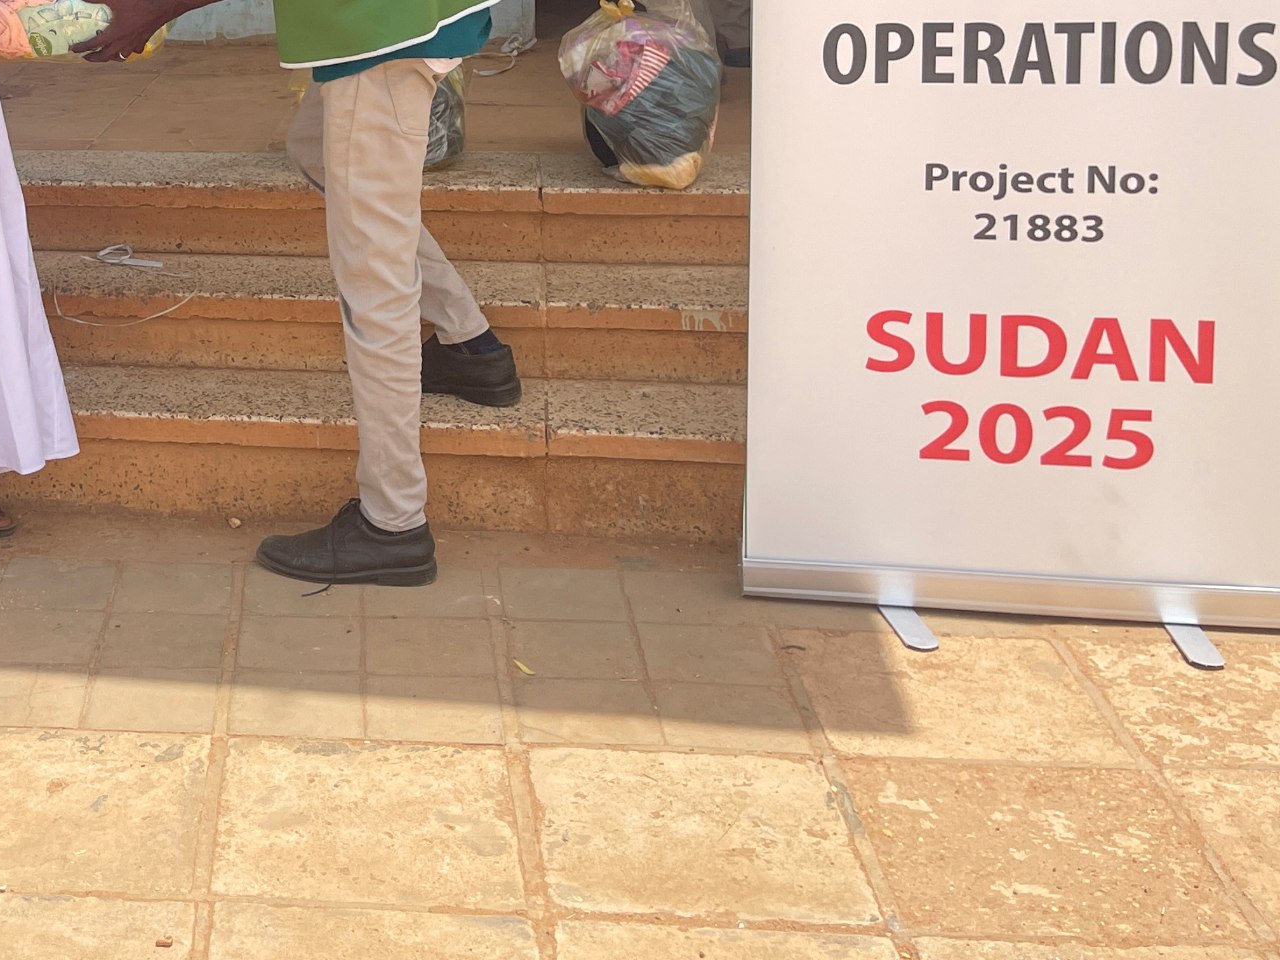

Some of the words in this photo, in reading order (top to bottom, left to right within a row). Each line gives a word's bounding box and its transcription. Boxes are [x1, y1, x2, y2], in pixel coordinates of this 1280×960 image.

[822, 20, 1278, 87] OPERATIONS
[924, 162, 1075, 201] Project
[1087, 165, 1159, 195] No:
[973, 212, 1105, 243] 21883
[865, 309, 1216, 385] SUDAN
[918, 399, 1155, 471] 2025
